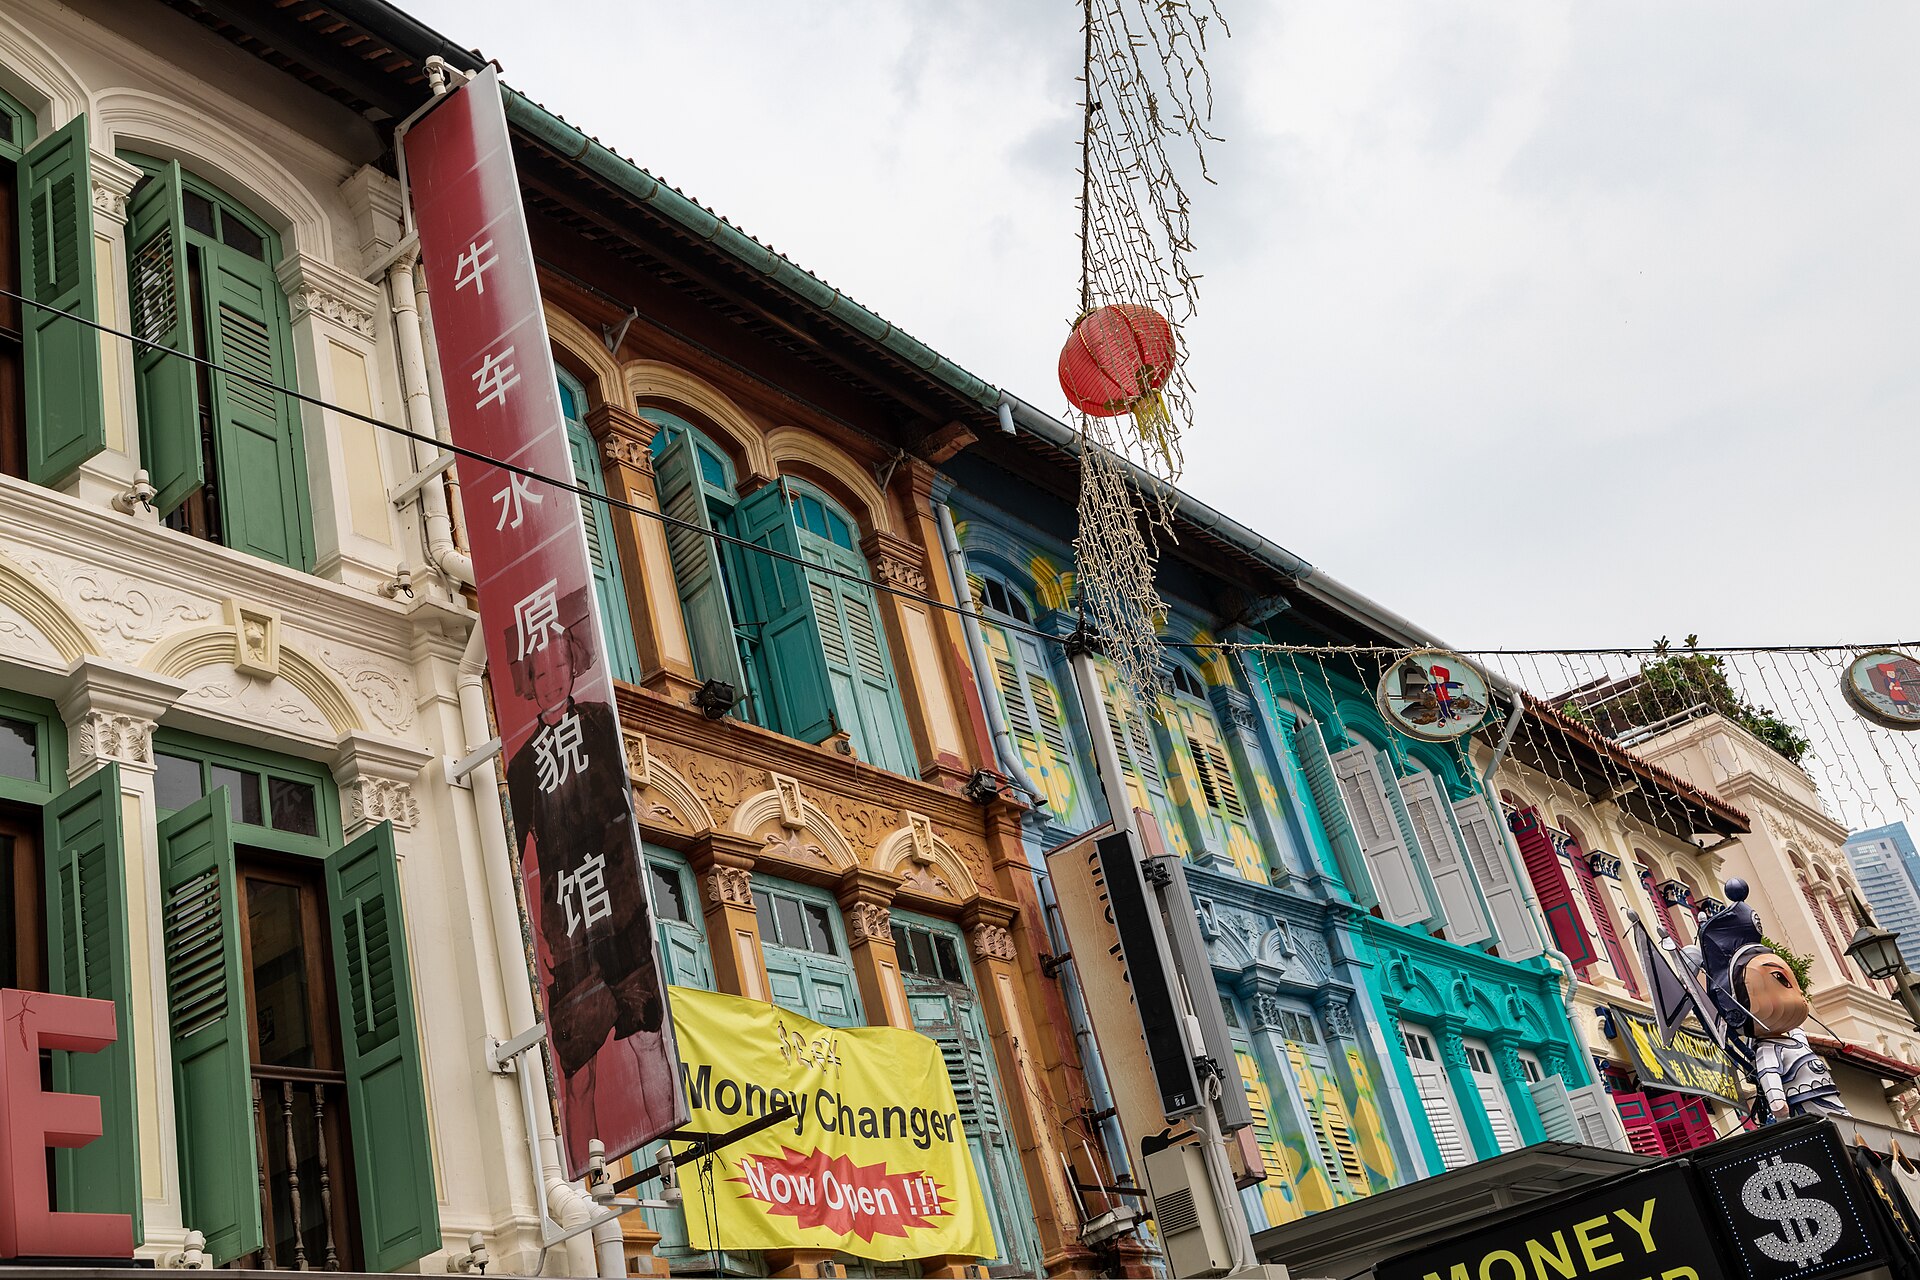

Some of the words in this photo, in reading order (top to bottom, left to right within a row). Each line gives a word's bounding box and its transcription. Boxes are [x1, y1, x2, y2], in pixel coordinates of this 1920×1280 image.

[453, 240, 613, 939] 牛车水原貌馆
[682, 1062, 808, 1135] Money
[815, 1088, 957, 1150] Changer
[742, 1159, 815, 1206] Now
[822, 1170, 898, 1221] Open
[903, 1176, 942, 1216] !!!
[1421, 1197, 1657, 1280] ONEY
